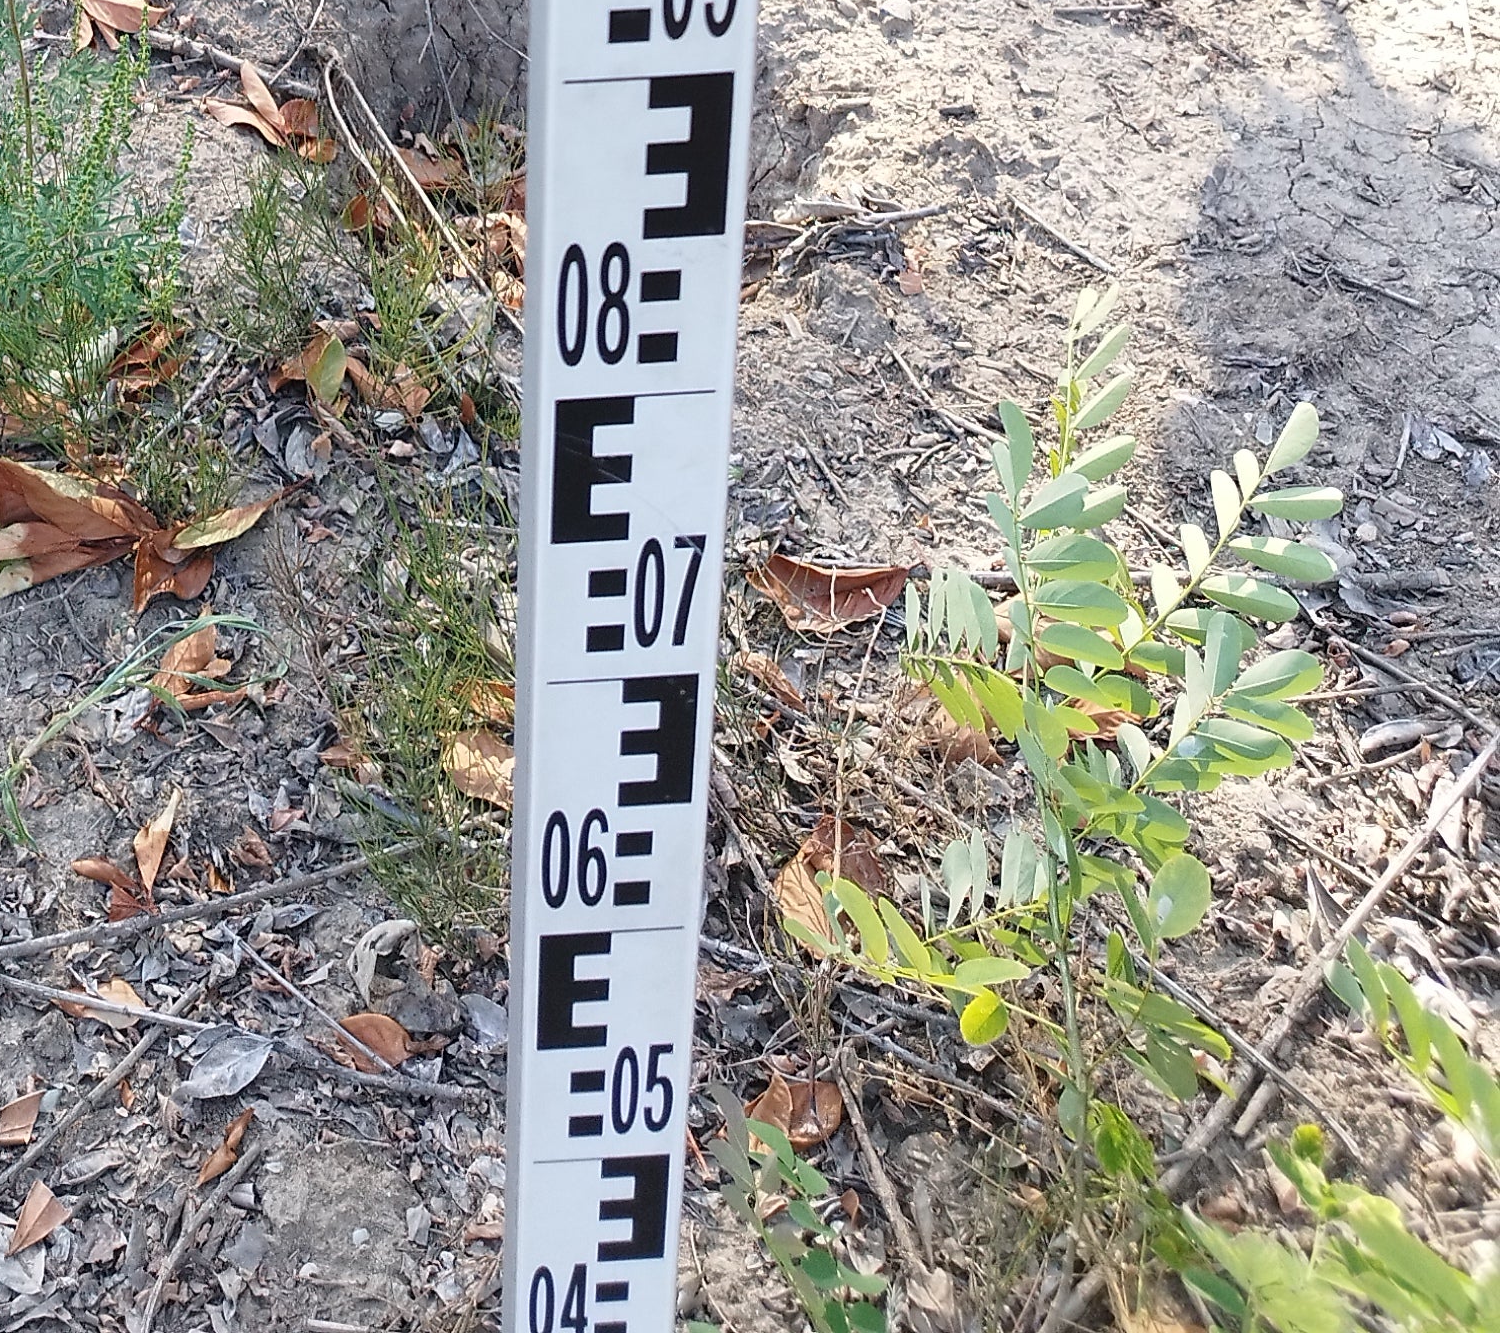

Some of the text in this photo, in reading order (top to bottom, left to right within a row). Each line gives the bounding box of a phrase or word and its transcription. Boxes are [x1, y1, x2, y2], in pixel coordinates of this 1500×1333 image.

[556, 241, 632, 368] 08
[632, 533, 708, 649] 07
[540, 807, 610, 910] 06
[610, 1041, 675, 1135] 05
